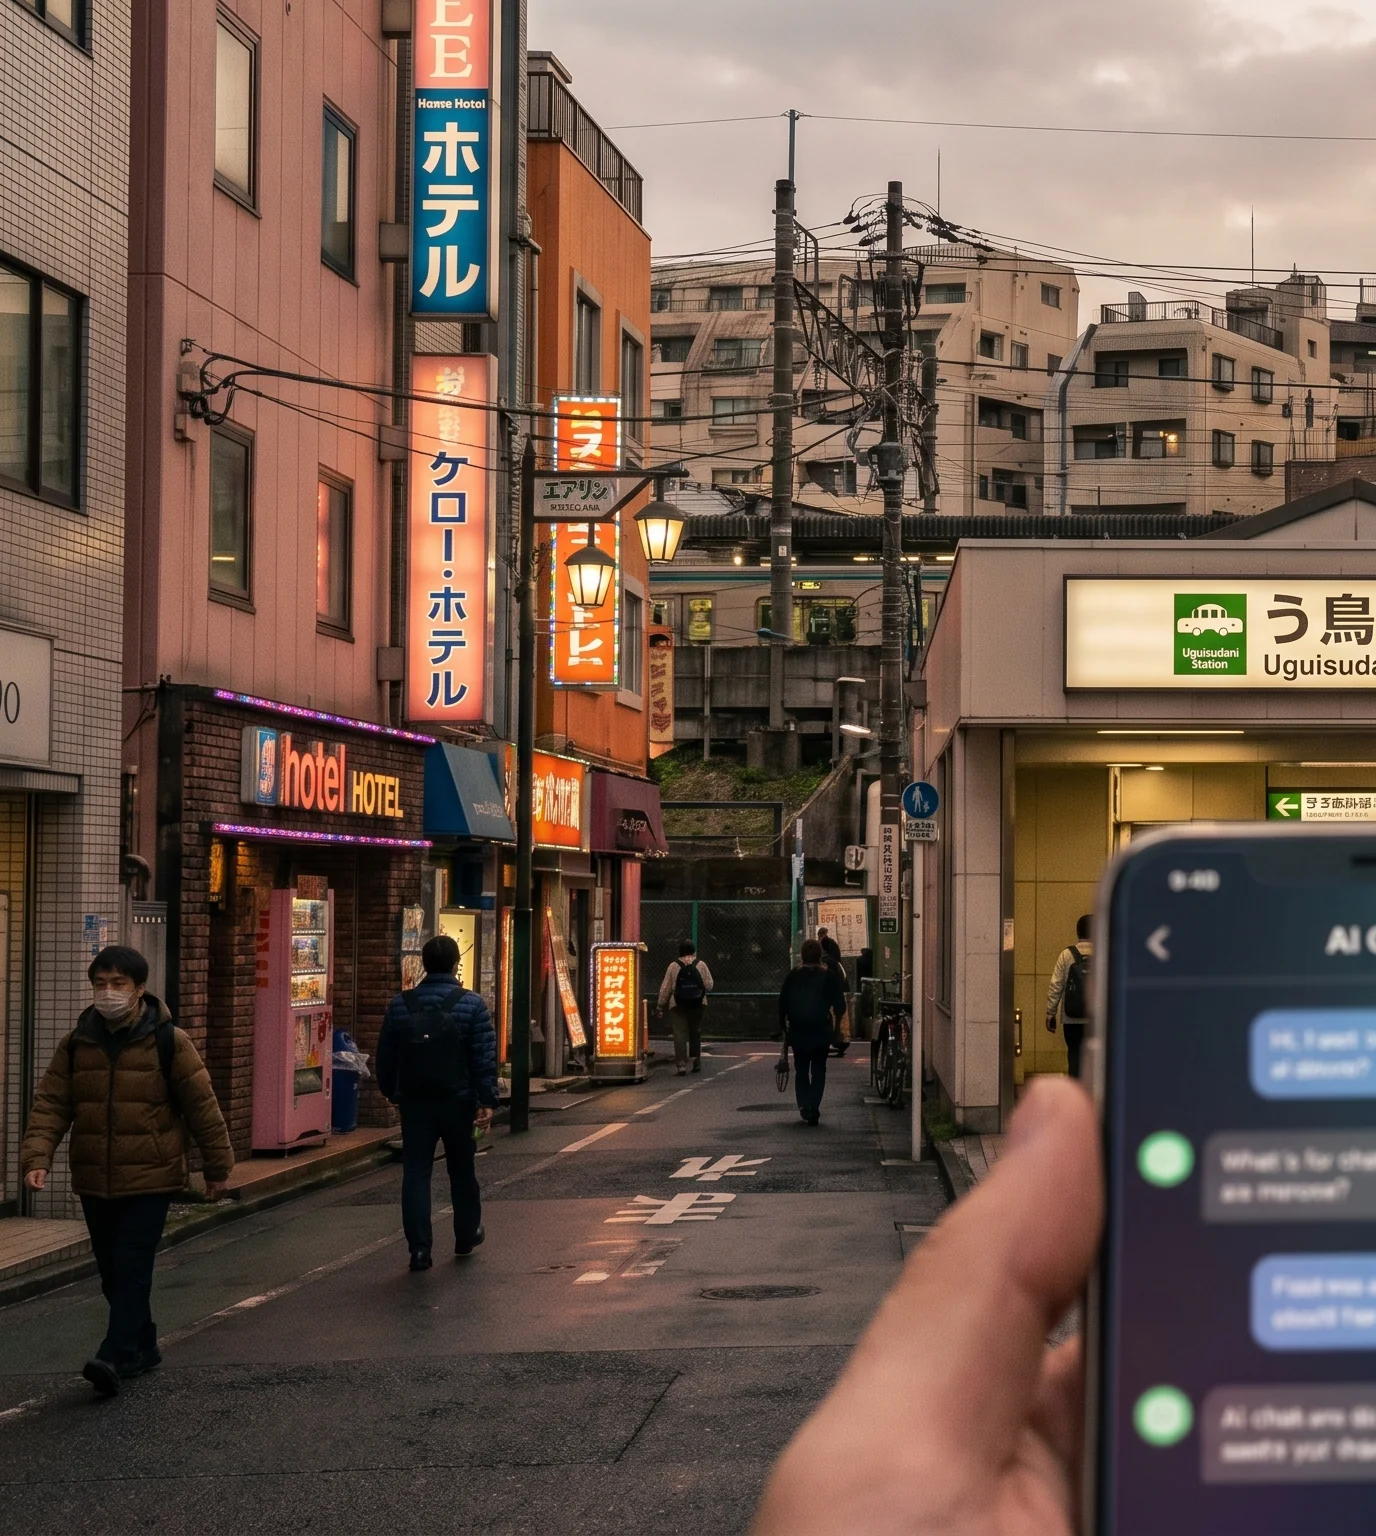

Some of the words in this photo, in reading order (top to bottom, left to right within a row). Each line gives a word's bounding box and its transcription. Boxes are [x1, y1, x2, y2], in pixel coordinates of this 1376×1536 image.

[419, 122, 480, 298] ホテル
[1182, 647, 1240, 660] Uguisudani
[1191, 659, 1228, 669] Station
[283, 733, 346, 812] hotel
[352, 770, 404, 818] HOTEL
